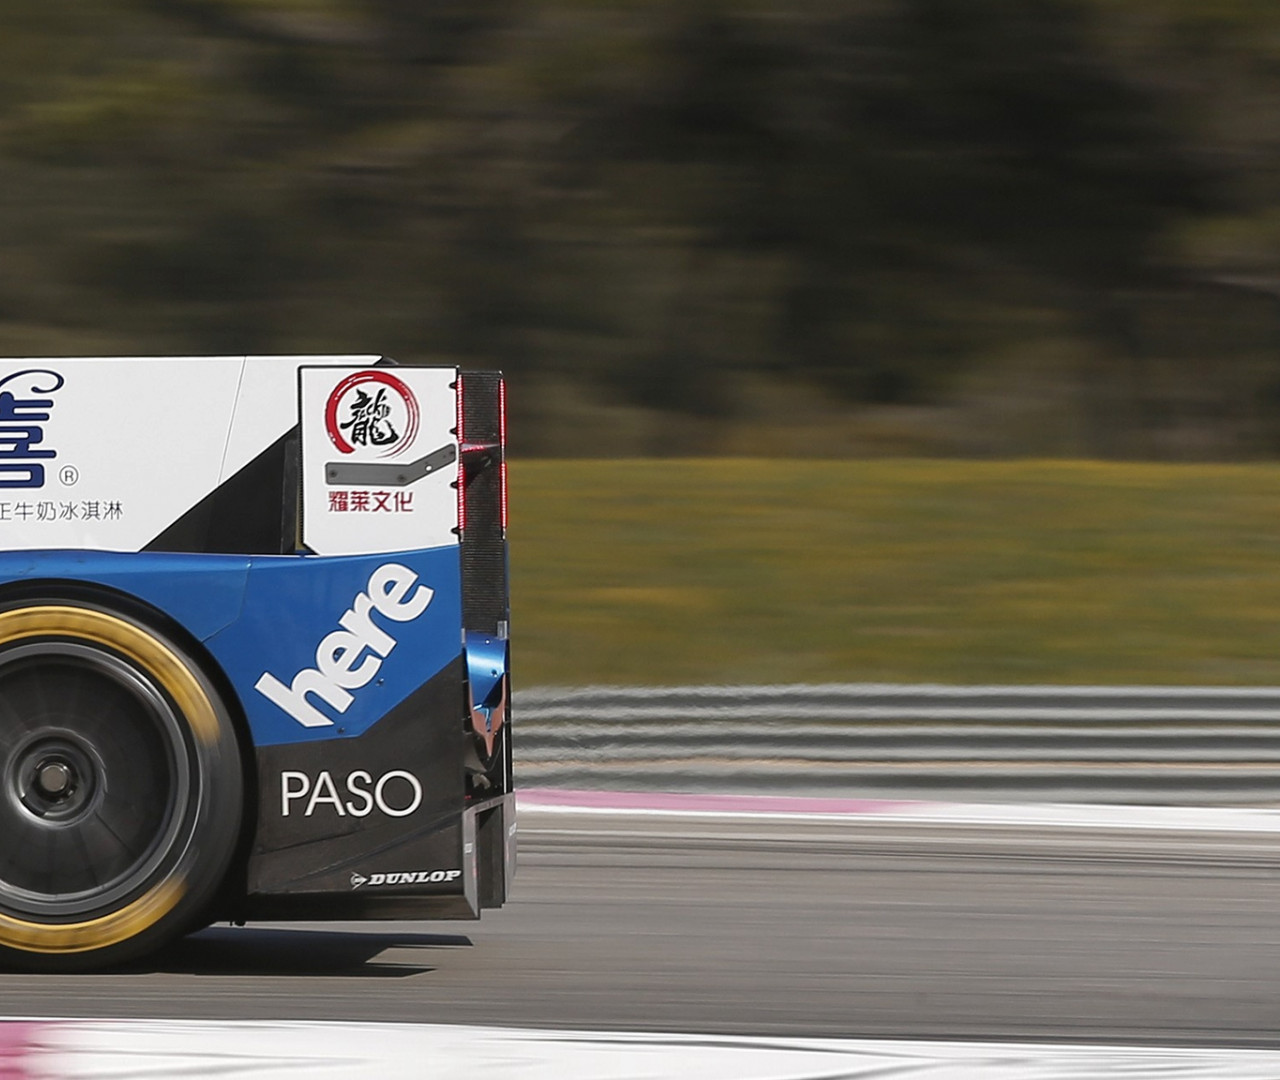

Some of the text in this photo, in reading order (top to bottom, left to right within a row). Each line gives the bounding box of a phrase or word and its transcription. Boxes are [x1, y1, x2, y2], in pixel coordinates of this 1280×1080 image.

[328, 490, 414, 512] 耀莱文化
[253, 562, 435, 728] here
[281, 770, 423, 817] PASO
[367, 870, 462, 886] DUNLOP
